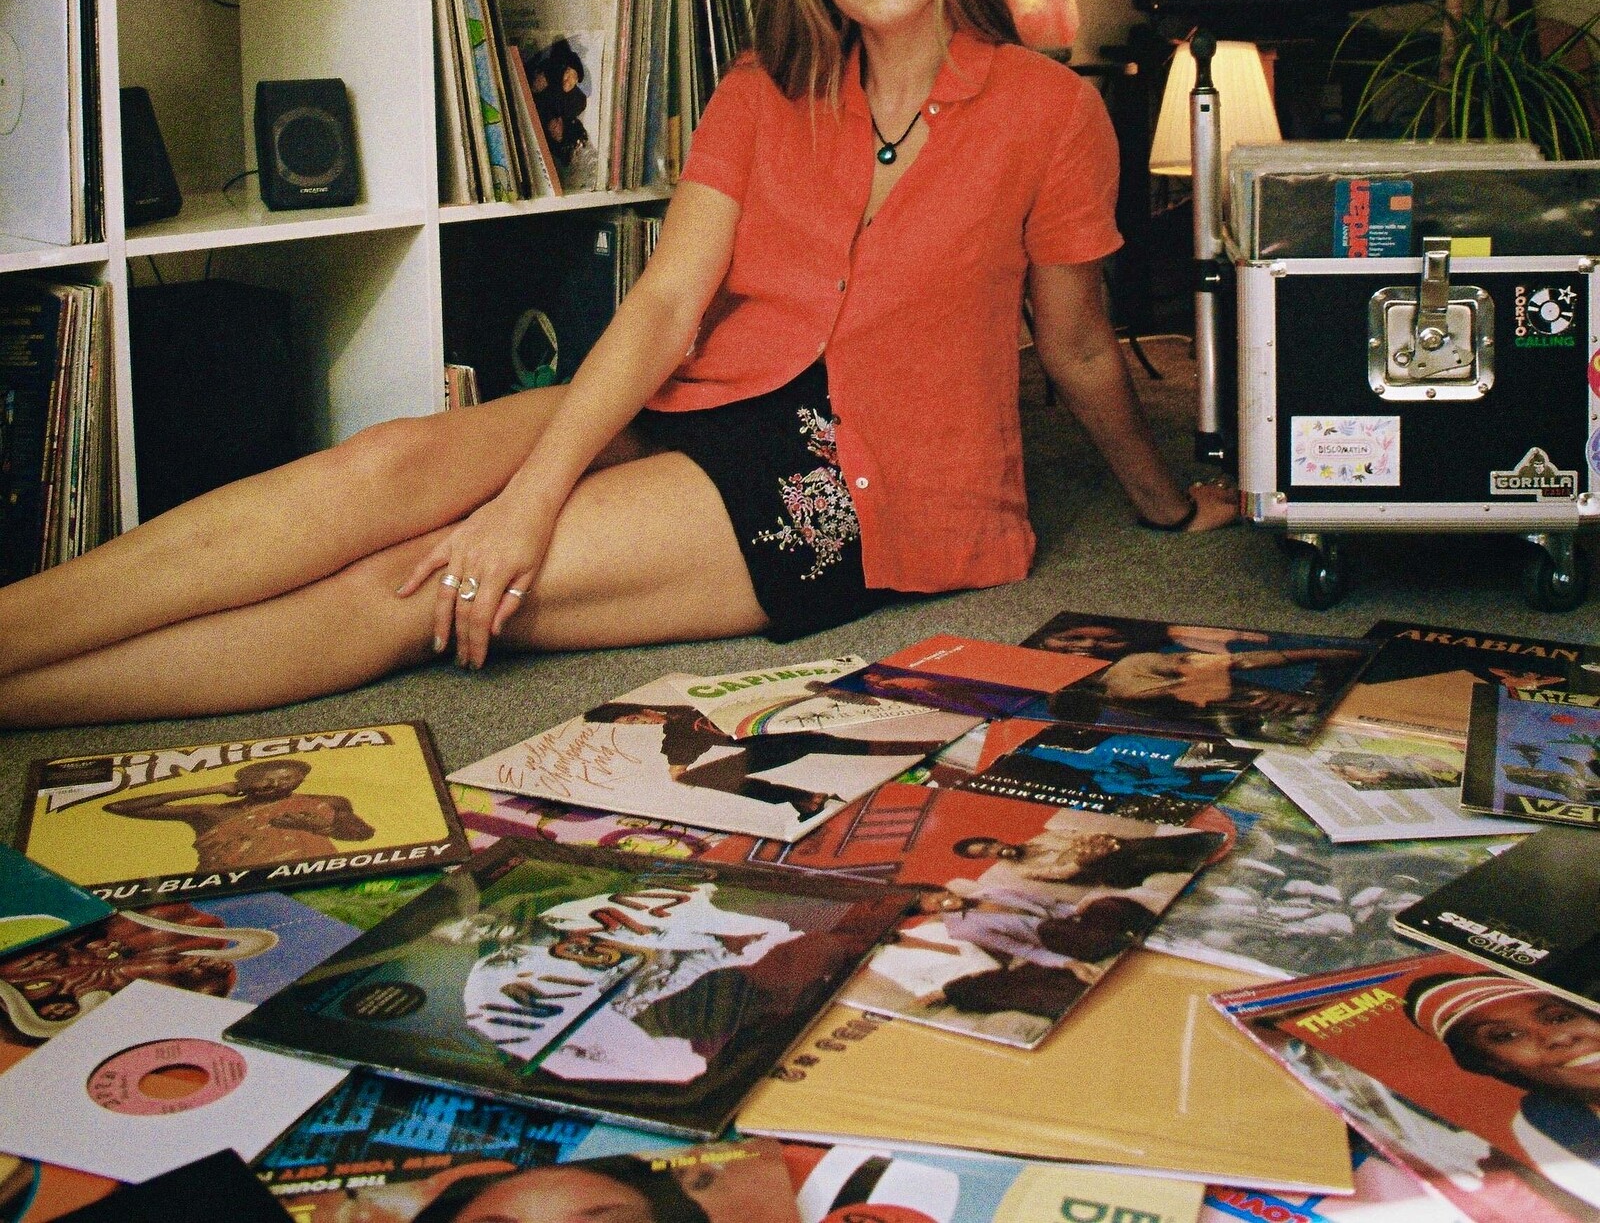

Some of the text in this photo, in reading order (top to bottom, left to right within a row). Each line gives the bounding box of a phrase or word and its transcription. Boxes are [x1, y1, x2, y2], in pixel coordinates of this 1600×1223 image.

[1515, 286, 1526, 337] PORTO
[1515, 337, 1575, 347] CALLING
[1496, 477, 1572, 488] GORILLA
[1395, 629, 1580, 662] ARABIAN
[968, 781, 1105, 810] HAROLD MELVIN
[267, 843, 453, 878] AMBOLLEY
[1437, 912, 1550, 958] PLAYERS
[1468, 935, 1537, 965] OHIO
[1296, 987, 1398, 1033] THELMA
